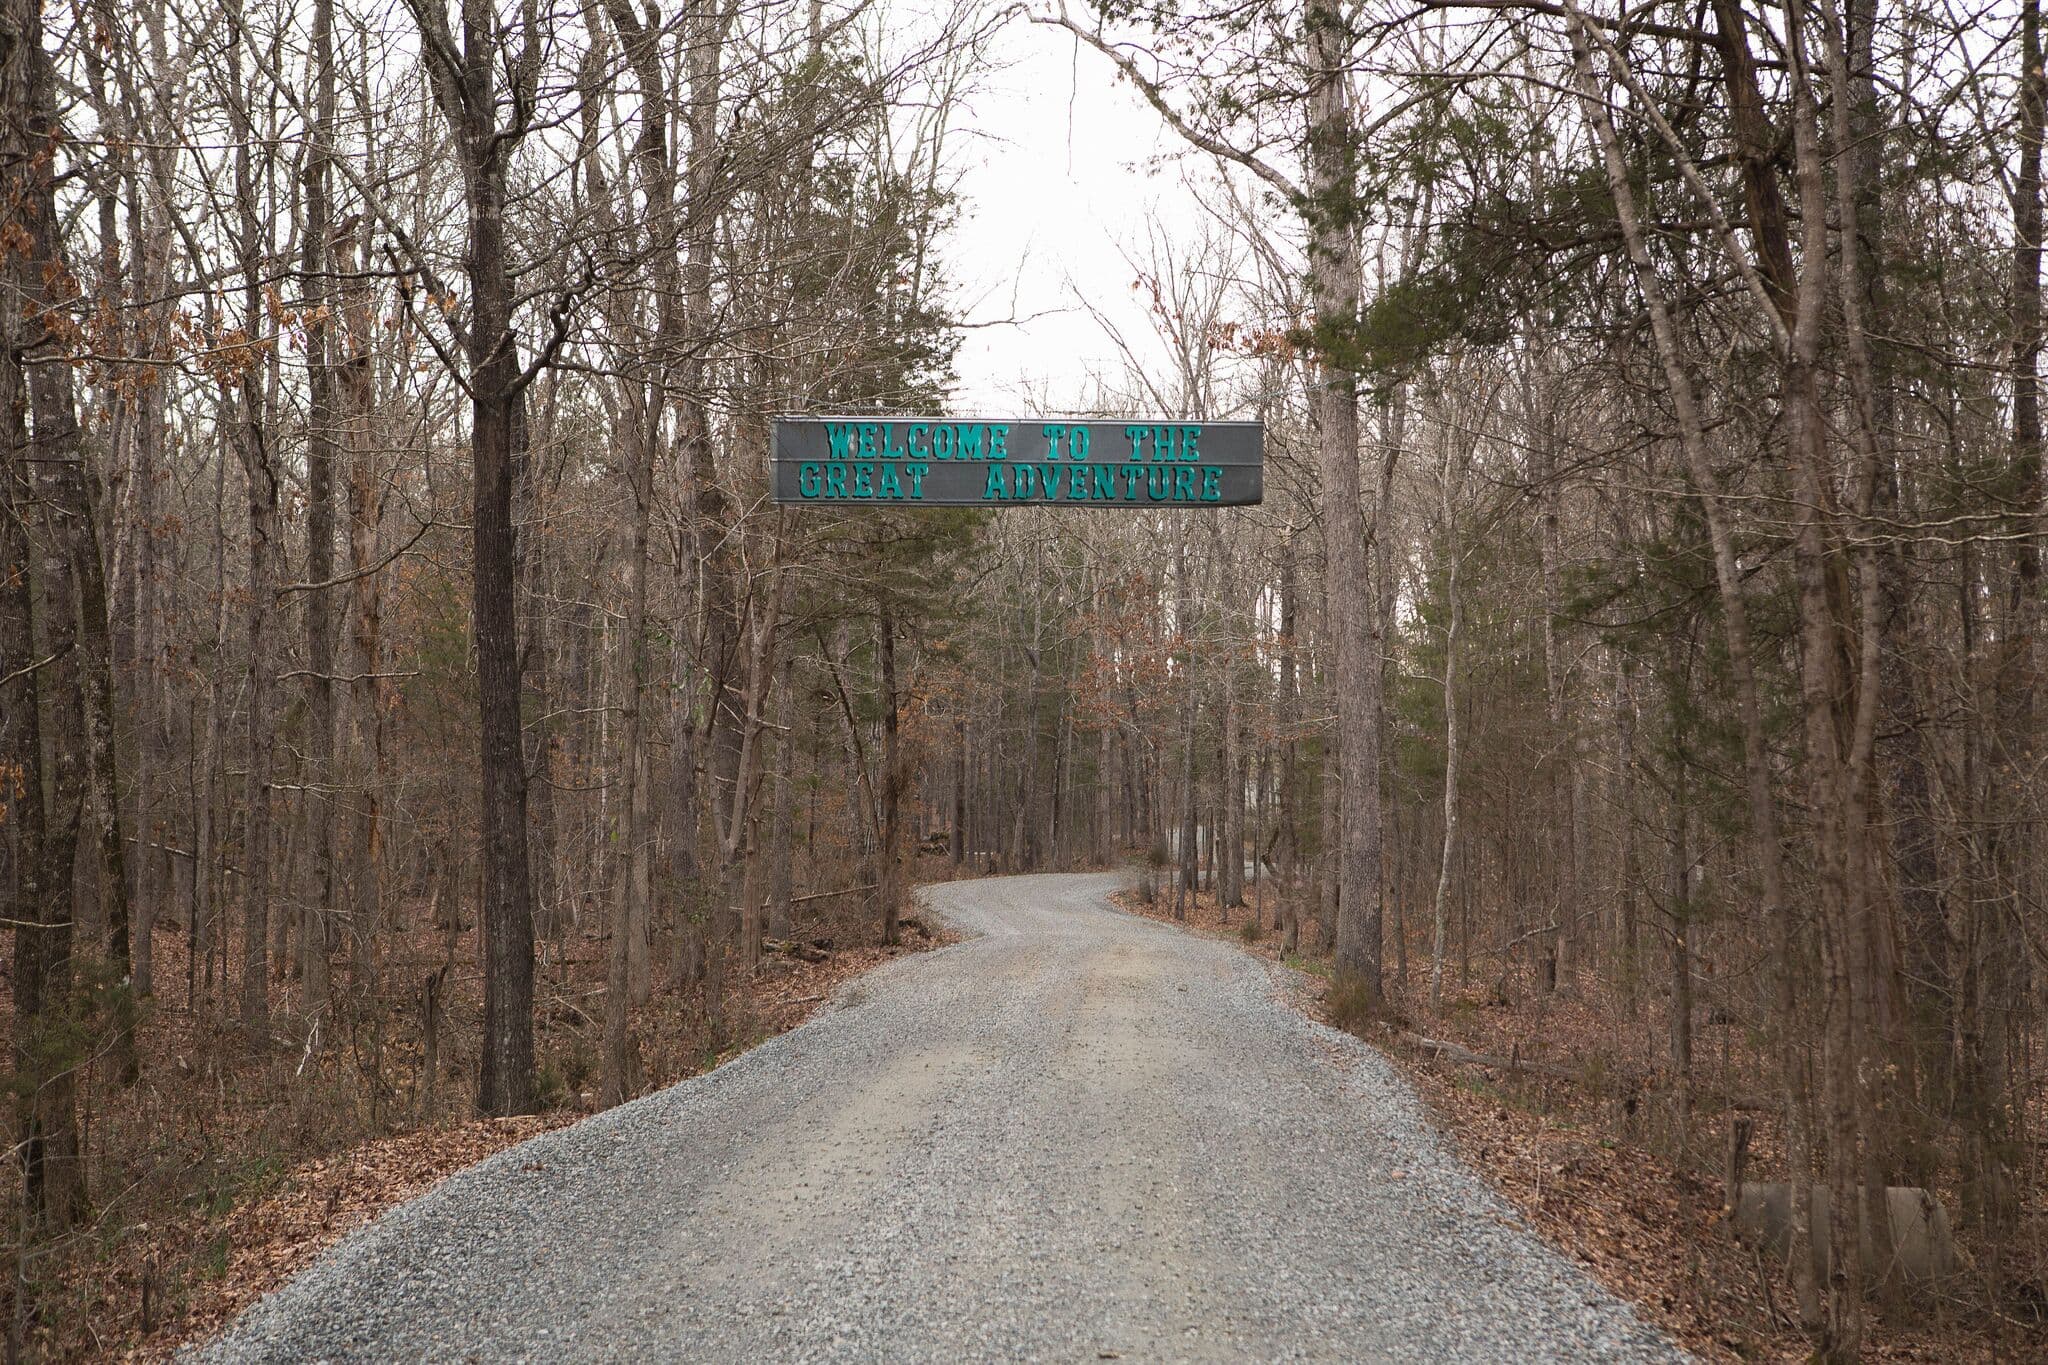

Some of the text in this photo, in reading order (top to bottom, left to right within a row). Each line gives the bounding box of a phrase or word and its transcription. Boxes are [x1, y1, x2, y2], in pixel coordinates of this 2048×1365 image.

[825, 423, 1201, 462] WELCOME TO THE
[799, 463, 1223, 501] GREAT ADVENTURE
